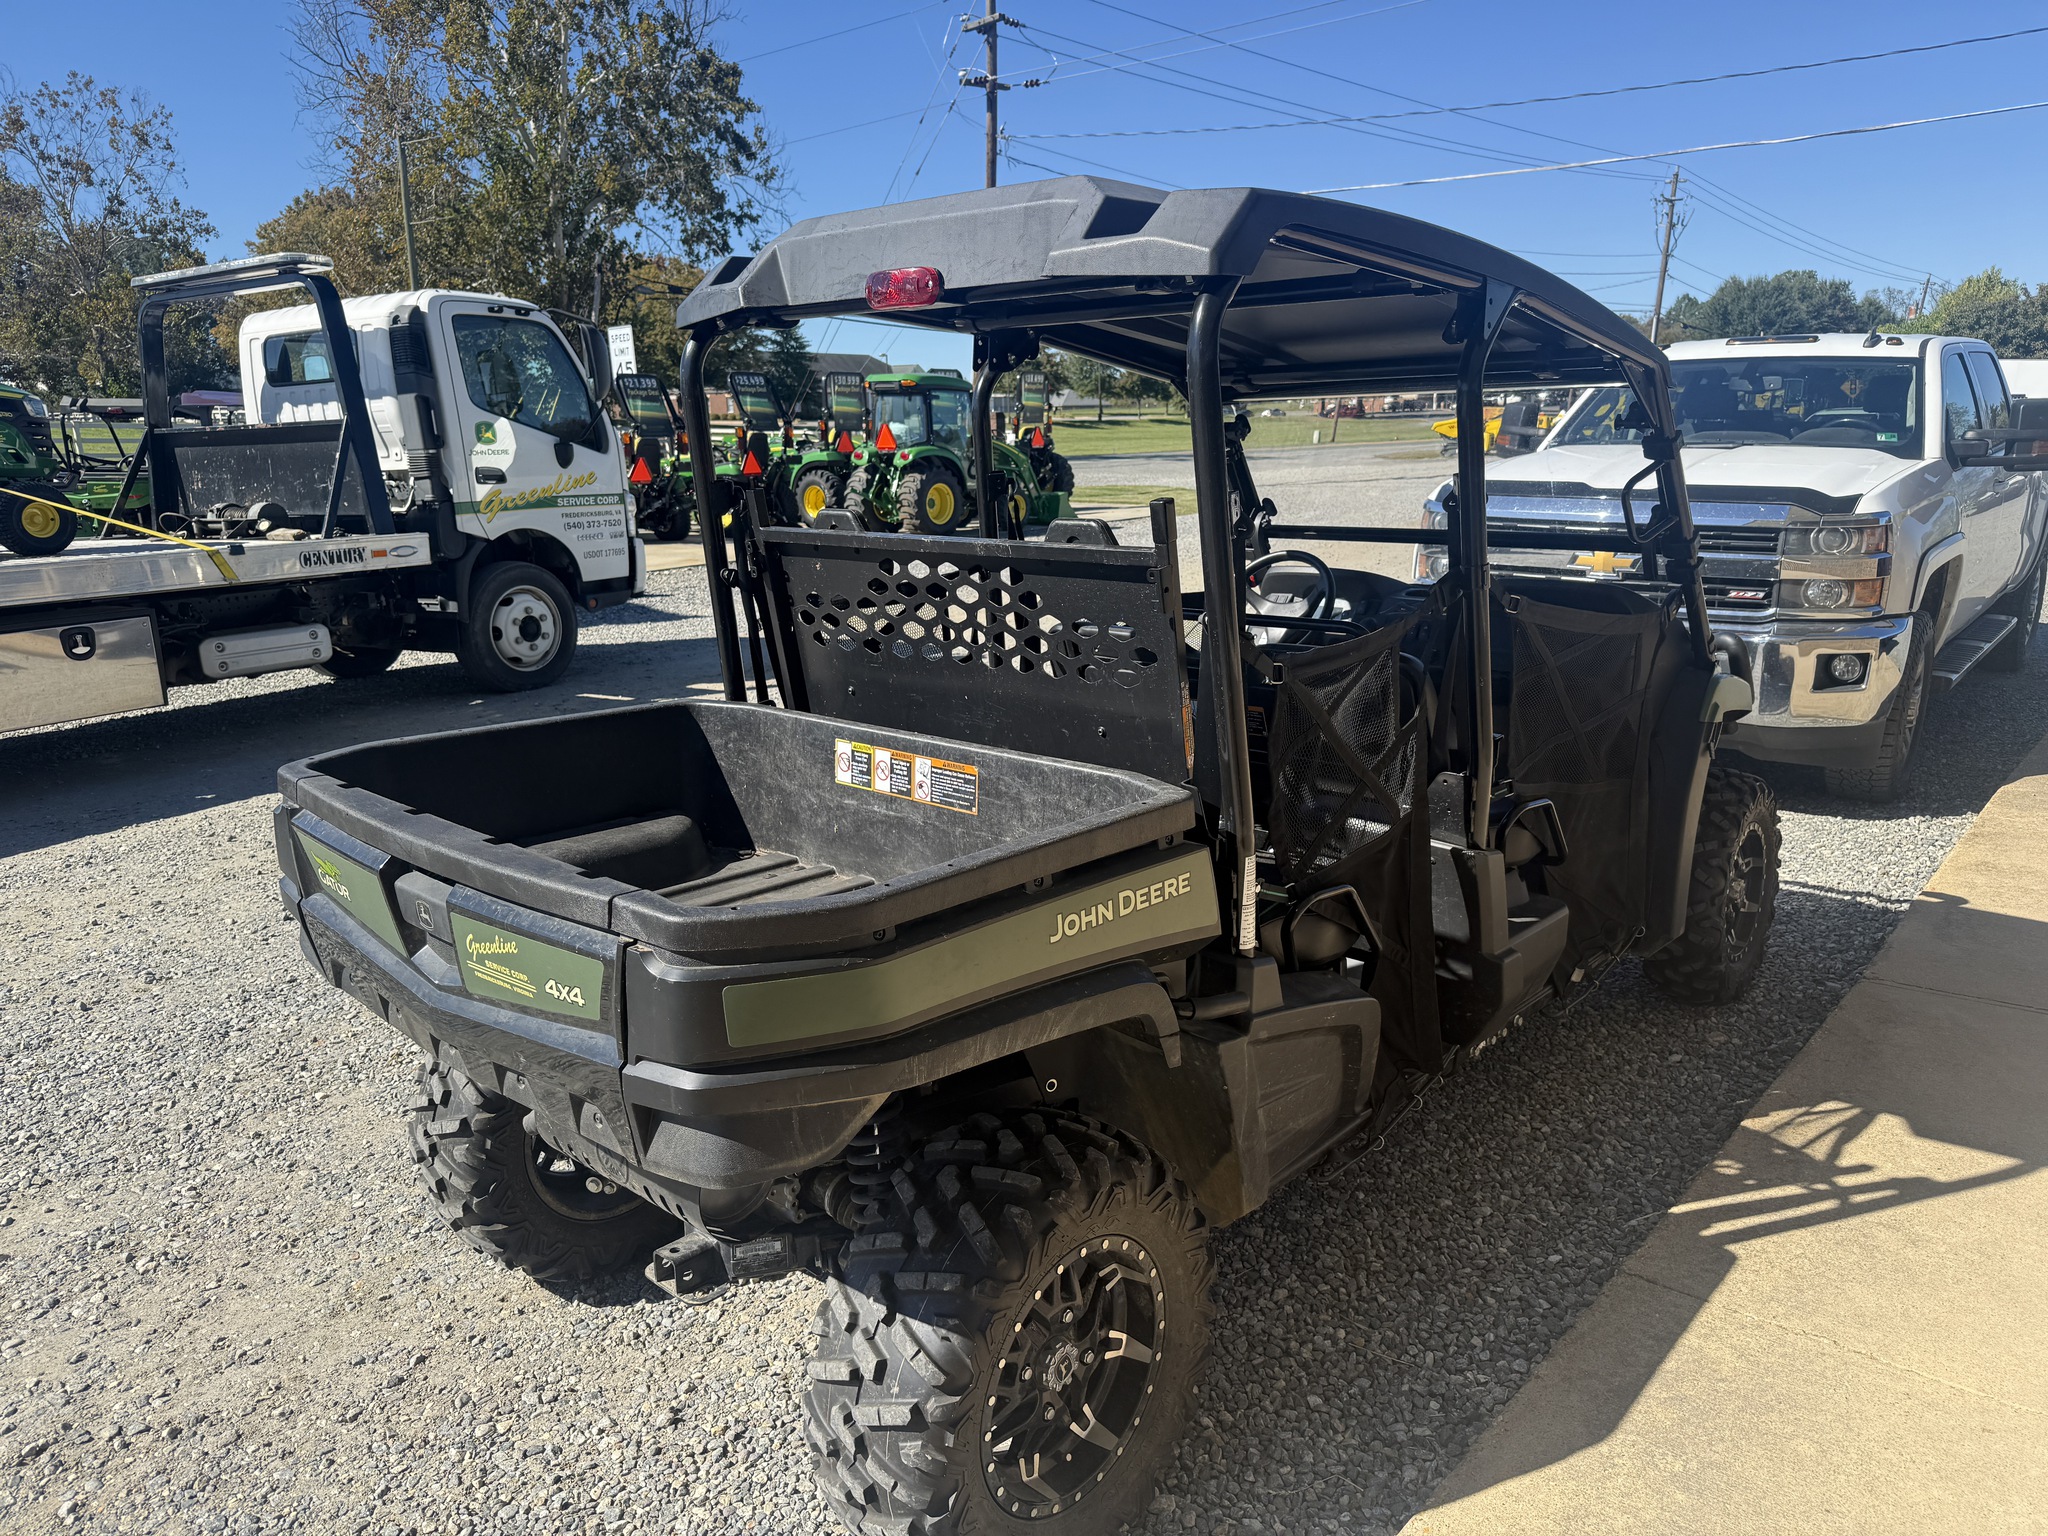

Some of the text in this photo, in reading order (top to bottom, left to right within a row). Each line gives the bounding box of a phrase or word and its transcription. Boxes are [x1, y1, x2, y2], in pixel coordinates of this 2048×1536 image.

[611, 333, 630, 343] SPEED
[614, 347, 629, 357] LIMIT
[624, 377, 657, 388] $21,399
[468, 448, 510, 457] JOHN DEERE
[479, 471, 598, 524] Greenline
[557, 496, 621, 507] SERVICE CORP.
[561, 510, 614, 519] FREDERICKSBURG,
[563, 518, 622, 531] (540) 373-7520
[299, 547, 367, 569] CENTURY
[583, 547, 626, 560] USDOT 177695
[318, 866, 352, 902] GATOR
[1050, 899, 1114, 944] JOHN
[1118, 871, 1191, 917] DEERE
[466, 933, 518, 961] Greenline
[484, 960, 531, 983] SERVICE CORP.
